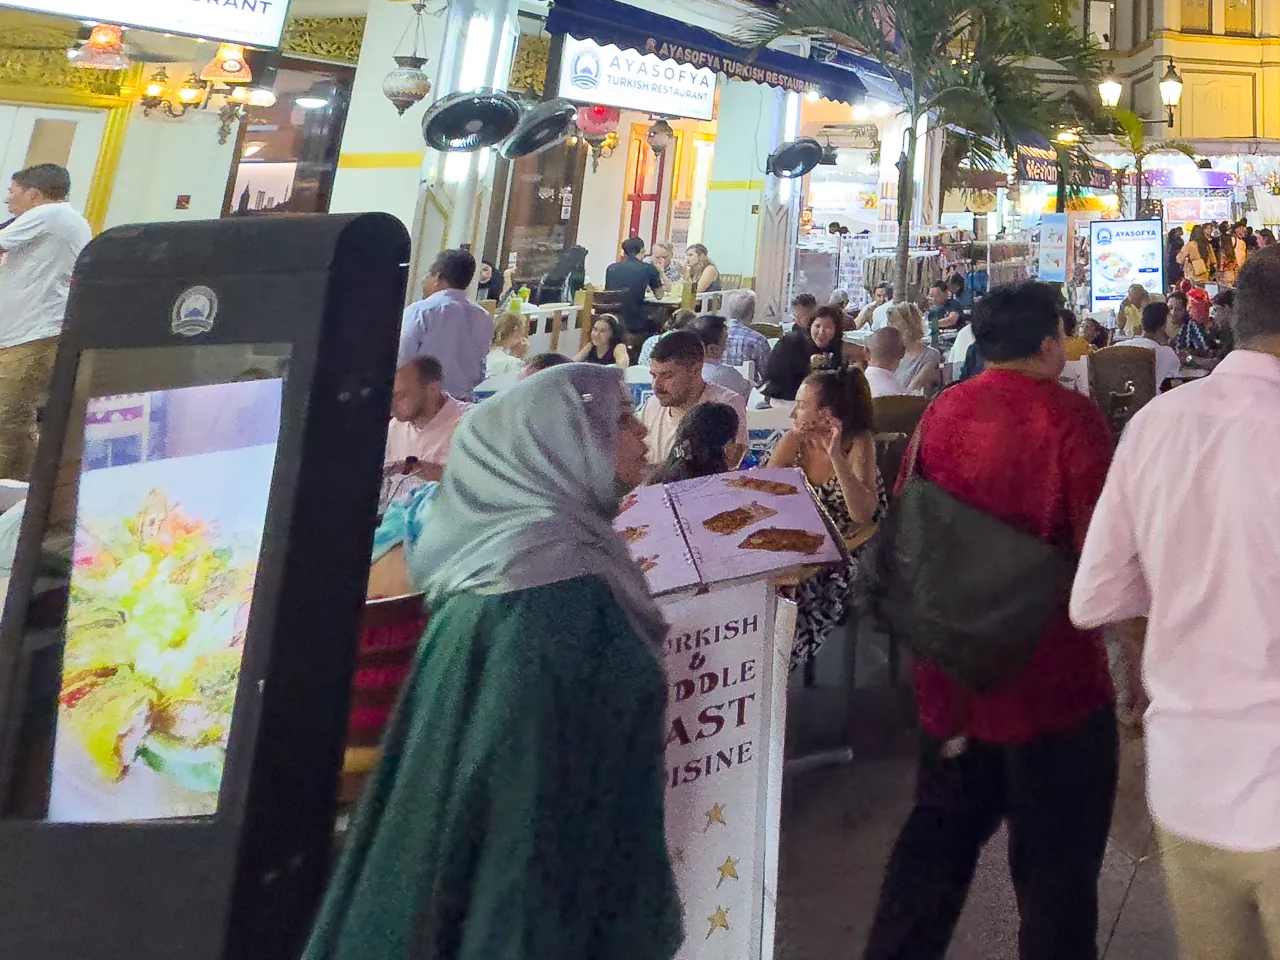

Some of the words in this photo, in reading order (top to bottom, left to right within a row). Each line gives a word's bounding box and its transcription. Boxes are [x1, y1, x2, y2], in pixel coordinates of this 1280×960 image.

[609, 55, 709, 88] AYASOFYA
[659, 41, 721, 70] AYASOFYA
[722, 58, 765, 82] TURKISH
[765, 71, 821, 93] RESTAURANT
[606, 74, 650, 90] TURKISH
[651, 84, 708, 101] RESTAURANT
[688, 651, 706, 671] &
